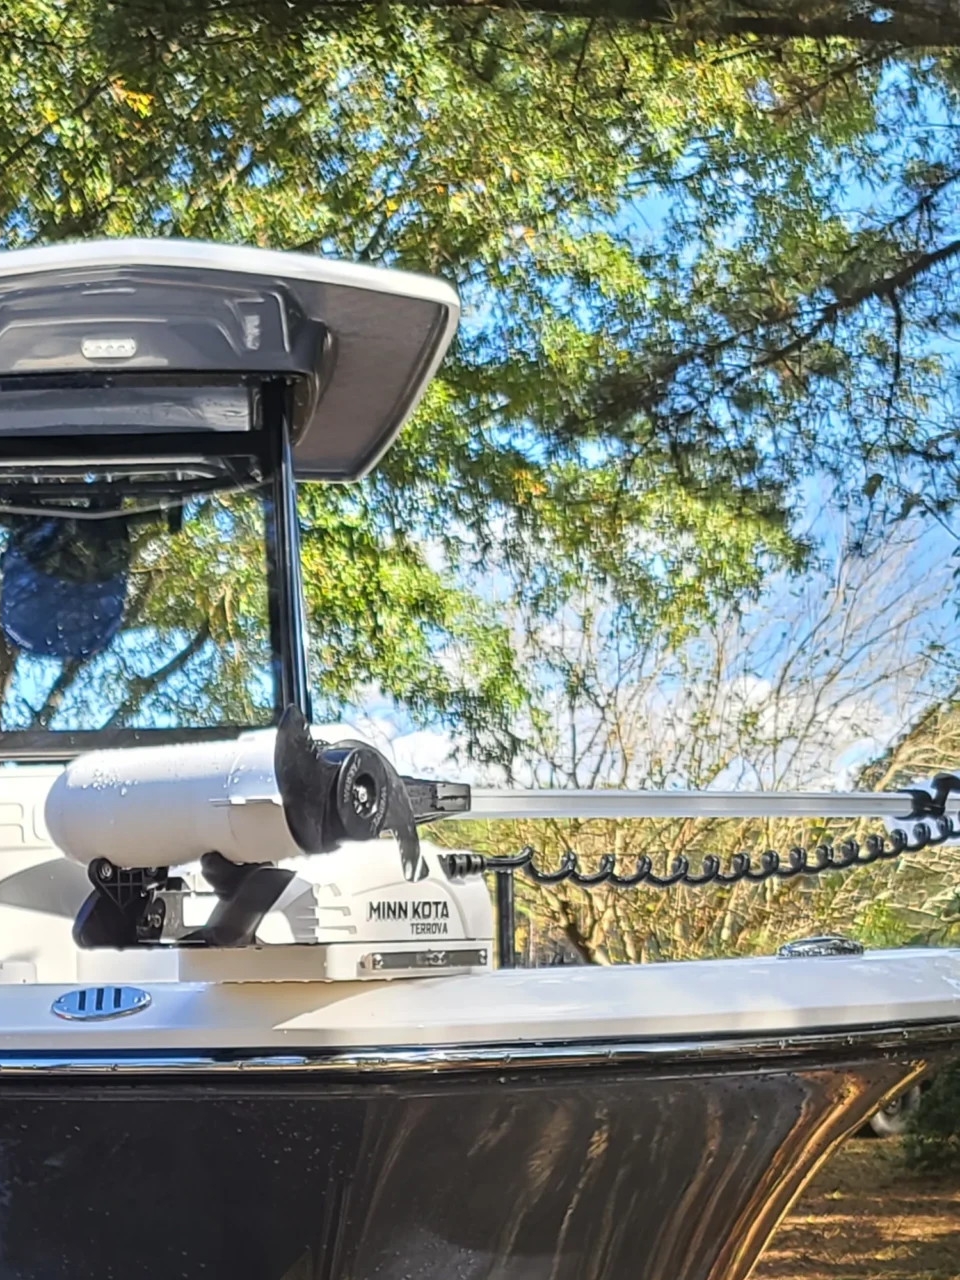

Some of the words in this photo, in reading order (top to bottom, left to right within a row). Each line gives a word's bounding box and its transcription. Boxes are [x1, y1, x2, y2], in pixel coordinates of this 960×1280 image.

[368, 900, 408, 920] MINN
[411, 900, 450, 919] KOTA
[410, 921, 449, 935] TERROVA
